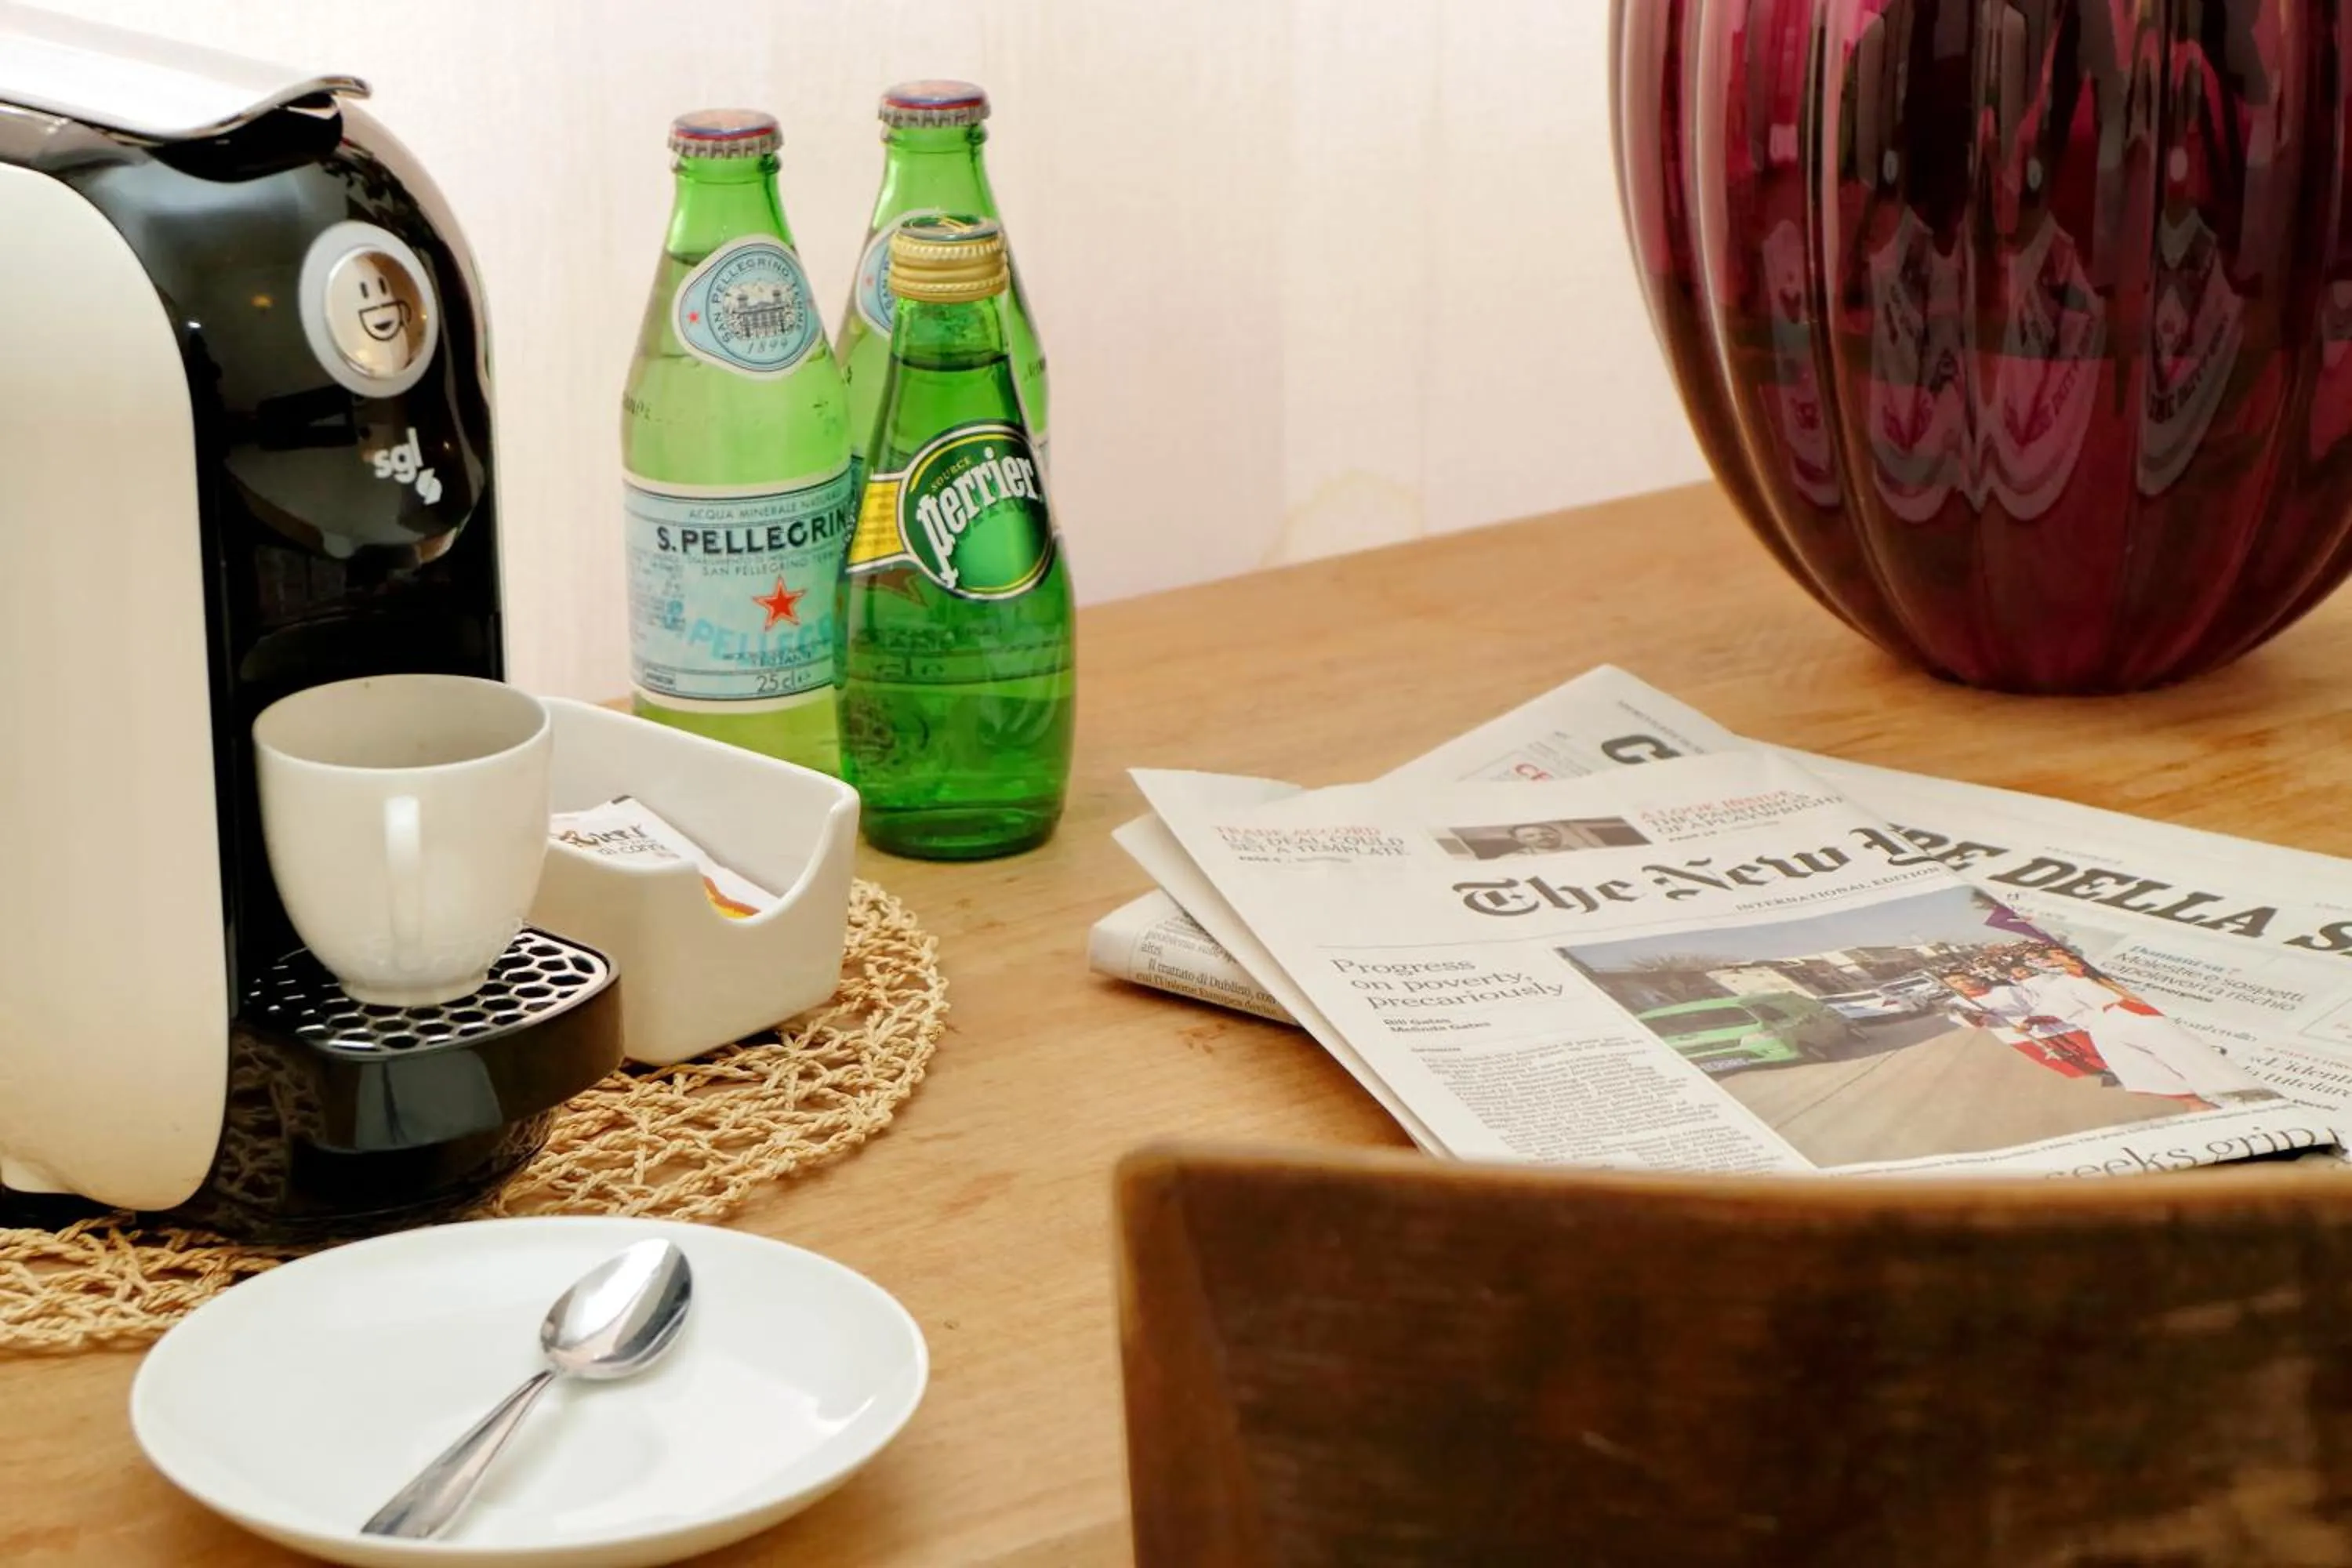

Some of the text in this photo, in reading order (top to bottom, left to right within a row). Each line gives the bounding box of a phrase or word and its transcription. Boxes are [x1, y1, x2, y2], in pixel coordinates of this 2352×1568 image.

[711, 257, 789, 303] PELLEGRINO
[689, 509, 734, 521] ACQUA
[739, 501, 797, 519] MINERALE
[702, 565, 730, 577] SAN
[1451, 875, 1642, 916] The
[1642, 846, 1853, 901] New
[1734, 866, 1940, 912] INTERNATIONAL EDITION
[1987, 856, 2279, 938] DELLA
[1330, 958, 1477, 977] Progress
[1350, 971, 1534, 993] on poverty,
[1366, 982, 1564, 1011] precariously
[1383, 1018, 1407, 1026] Bill
[1449, 1021, 1493, 1031] Gates
